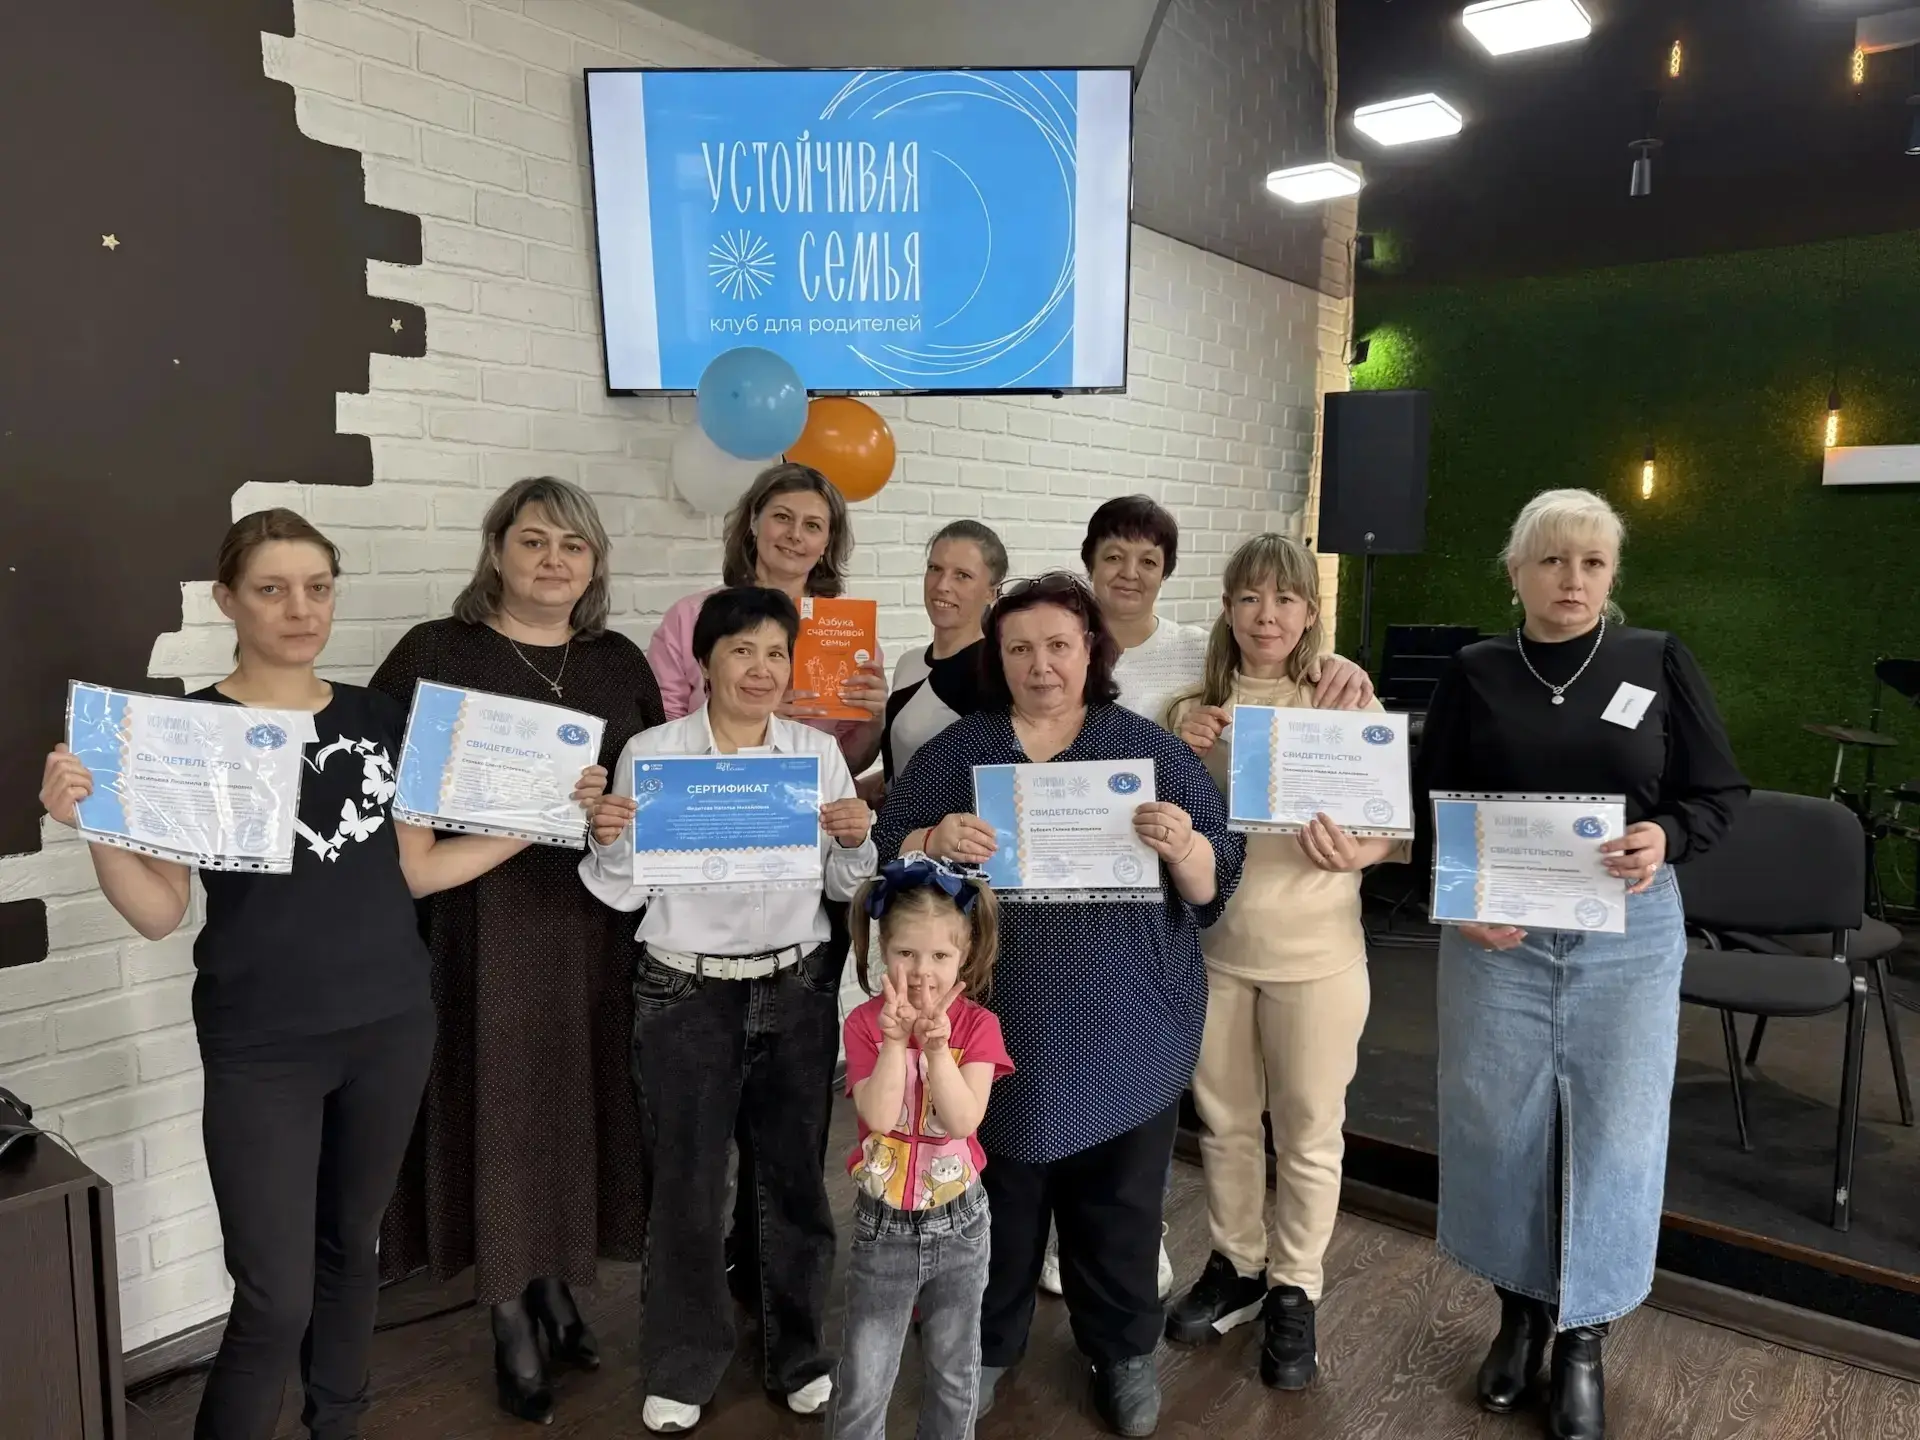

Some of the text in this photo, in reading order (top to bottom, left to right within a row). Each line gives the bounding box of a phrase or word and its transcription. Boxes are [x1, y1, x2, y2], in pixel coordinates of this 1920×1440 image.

[702, 129, 919, 213] УСТОЙЧИВАЯ
[710, 313, 921, 336] клуб для родителей
[818, 616, 854, 629] Азбука
[807, 628, 865, 637] счастливой
[820, 639, 851, 647] семьи
[687, 783, 770, 794] СЕРТИФИКАТ
[1029, 807, 1110, 817] СВИДЕТЕЛЬСТВО
